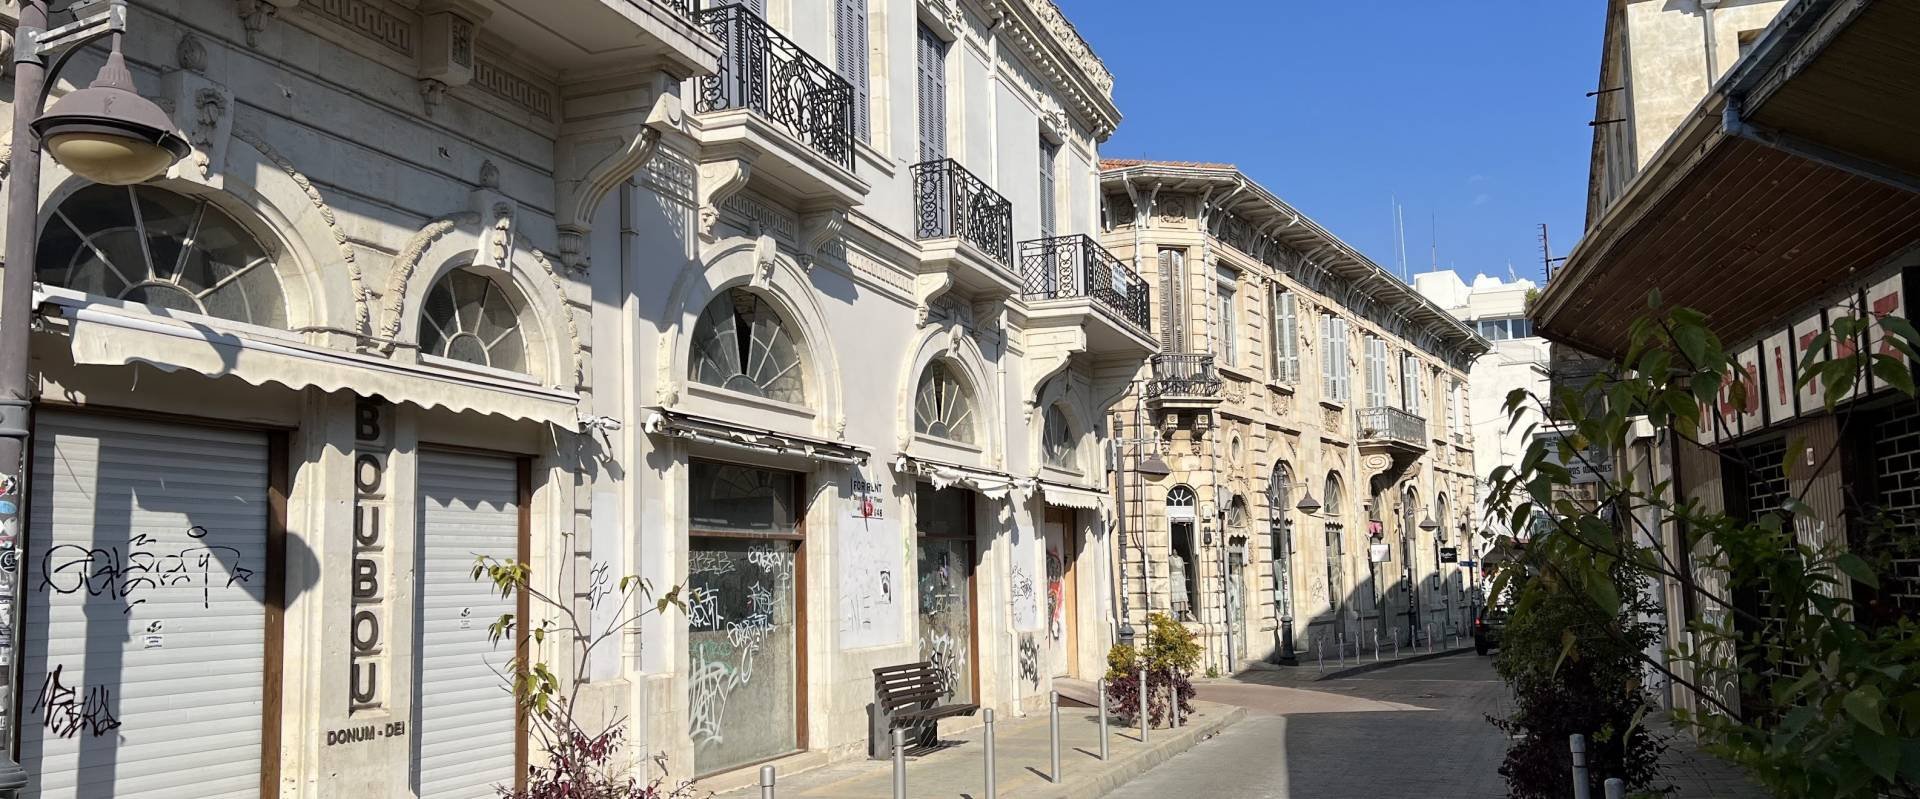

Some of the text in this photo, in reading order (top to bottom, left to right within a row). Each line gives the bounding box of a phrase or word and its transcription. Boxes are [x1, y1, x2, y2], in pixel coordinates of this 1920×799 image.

[853, 480, 882, 494] FOR RENT
[353, 402, 382, 704] BOUBOU
[327, 725, 375, 746] DONUM
[385, 721, 405, 738] DEI
